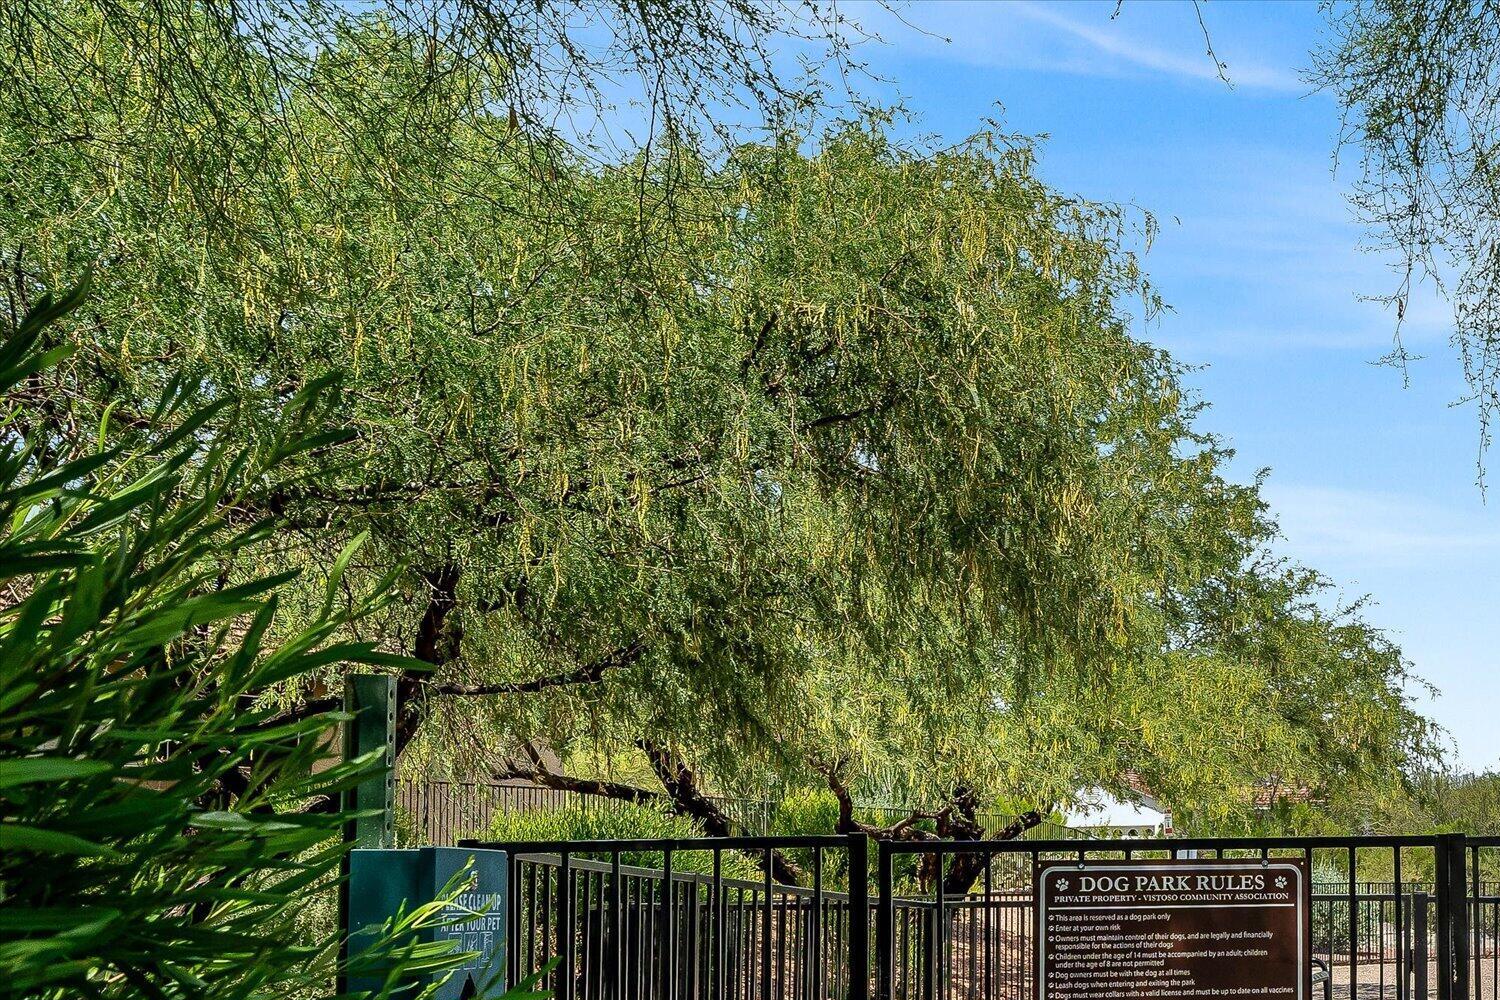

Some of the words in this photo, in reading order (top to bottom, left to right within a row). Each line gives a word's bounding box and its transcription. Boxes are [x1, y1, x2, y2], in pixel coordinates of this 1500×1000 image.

[1079, 876, 1129, 892] DOG
[1135, 876, 1191, 892] PARK
[1196, 875, 1265, 891] RULES
[1180, 893, 1233, 901] COMMUNITY
[1234, 892, 1289, 901] ASSOCIATION
[1129, 913, 1142, 922] dog
[1142, 913, 1157, 922] park
[1157, 913, 1171, 922] only
[487, 917, 500, 930] PET
[1210, 932, 1230, 941] legally
[1243, 931, 1274, 940] financially
[1056, 942, 1091, 951] responsible
[1158, 941, 1174, 950] dogs
[1167, 950, 1208, 959] accompanied
[1208, 950, 1216, 958] by
[1134, 959, 1165, 968] permitted
[1056, 971, 1069, 980] Dog
[1145, 969, 1158, 978] dog
[1074, 981, 1090, 990] dogs
[1109, 980, 1135, 989] entering
[1148, 980, 1170, 988] exiting
[1181, 978, 1196, 987] park
[1056, 991, 1072, 1000] Dogs
